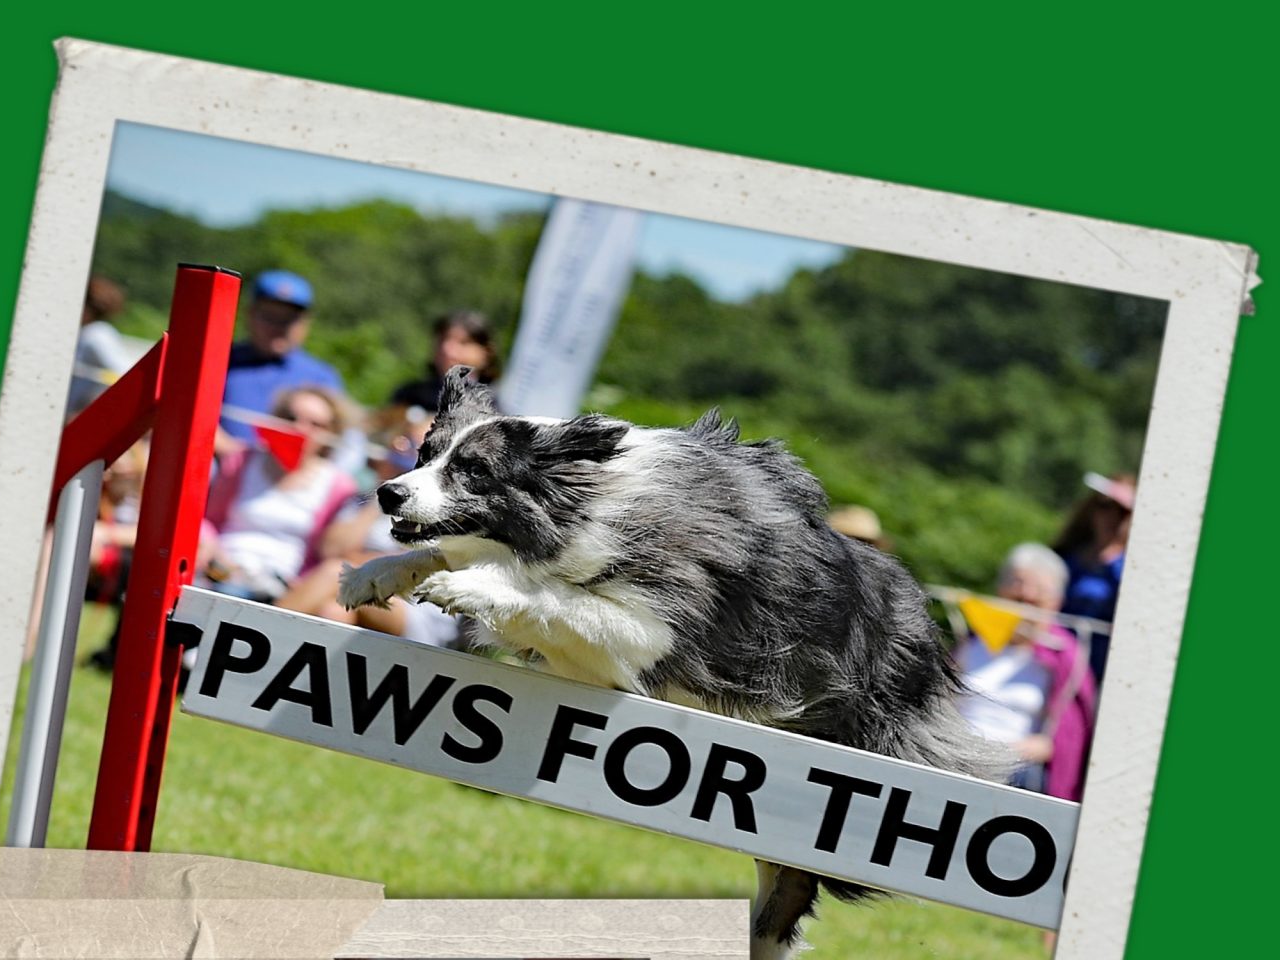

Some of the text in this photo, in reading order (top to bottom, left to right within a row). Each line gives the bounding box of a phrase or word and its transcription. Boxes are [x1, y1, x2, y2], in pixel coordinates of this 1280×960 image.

[199, 621, 1068, 897] PAWS FOR THO
